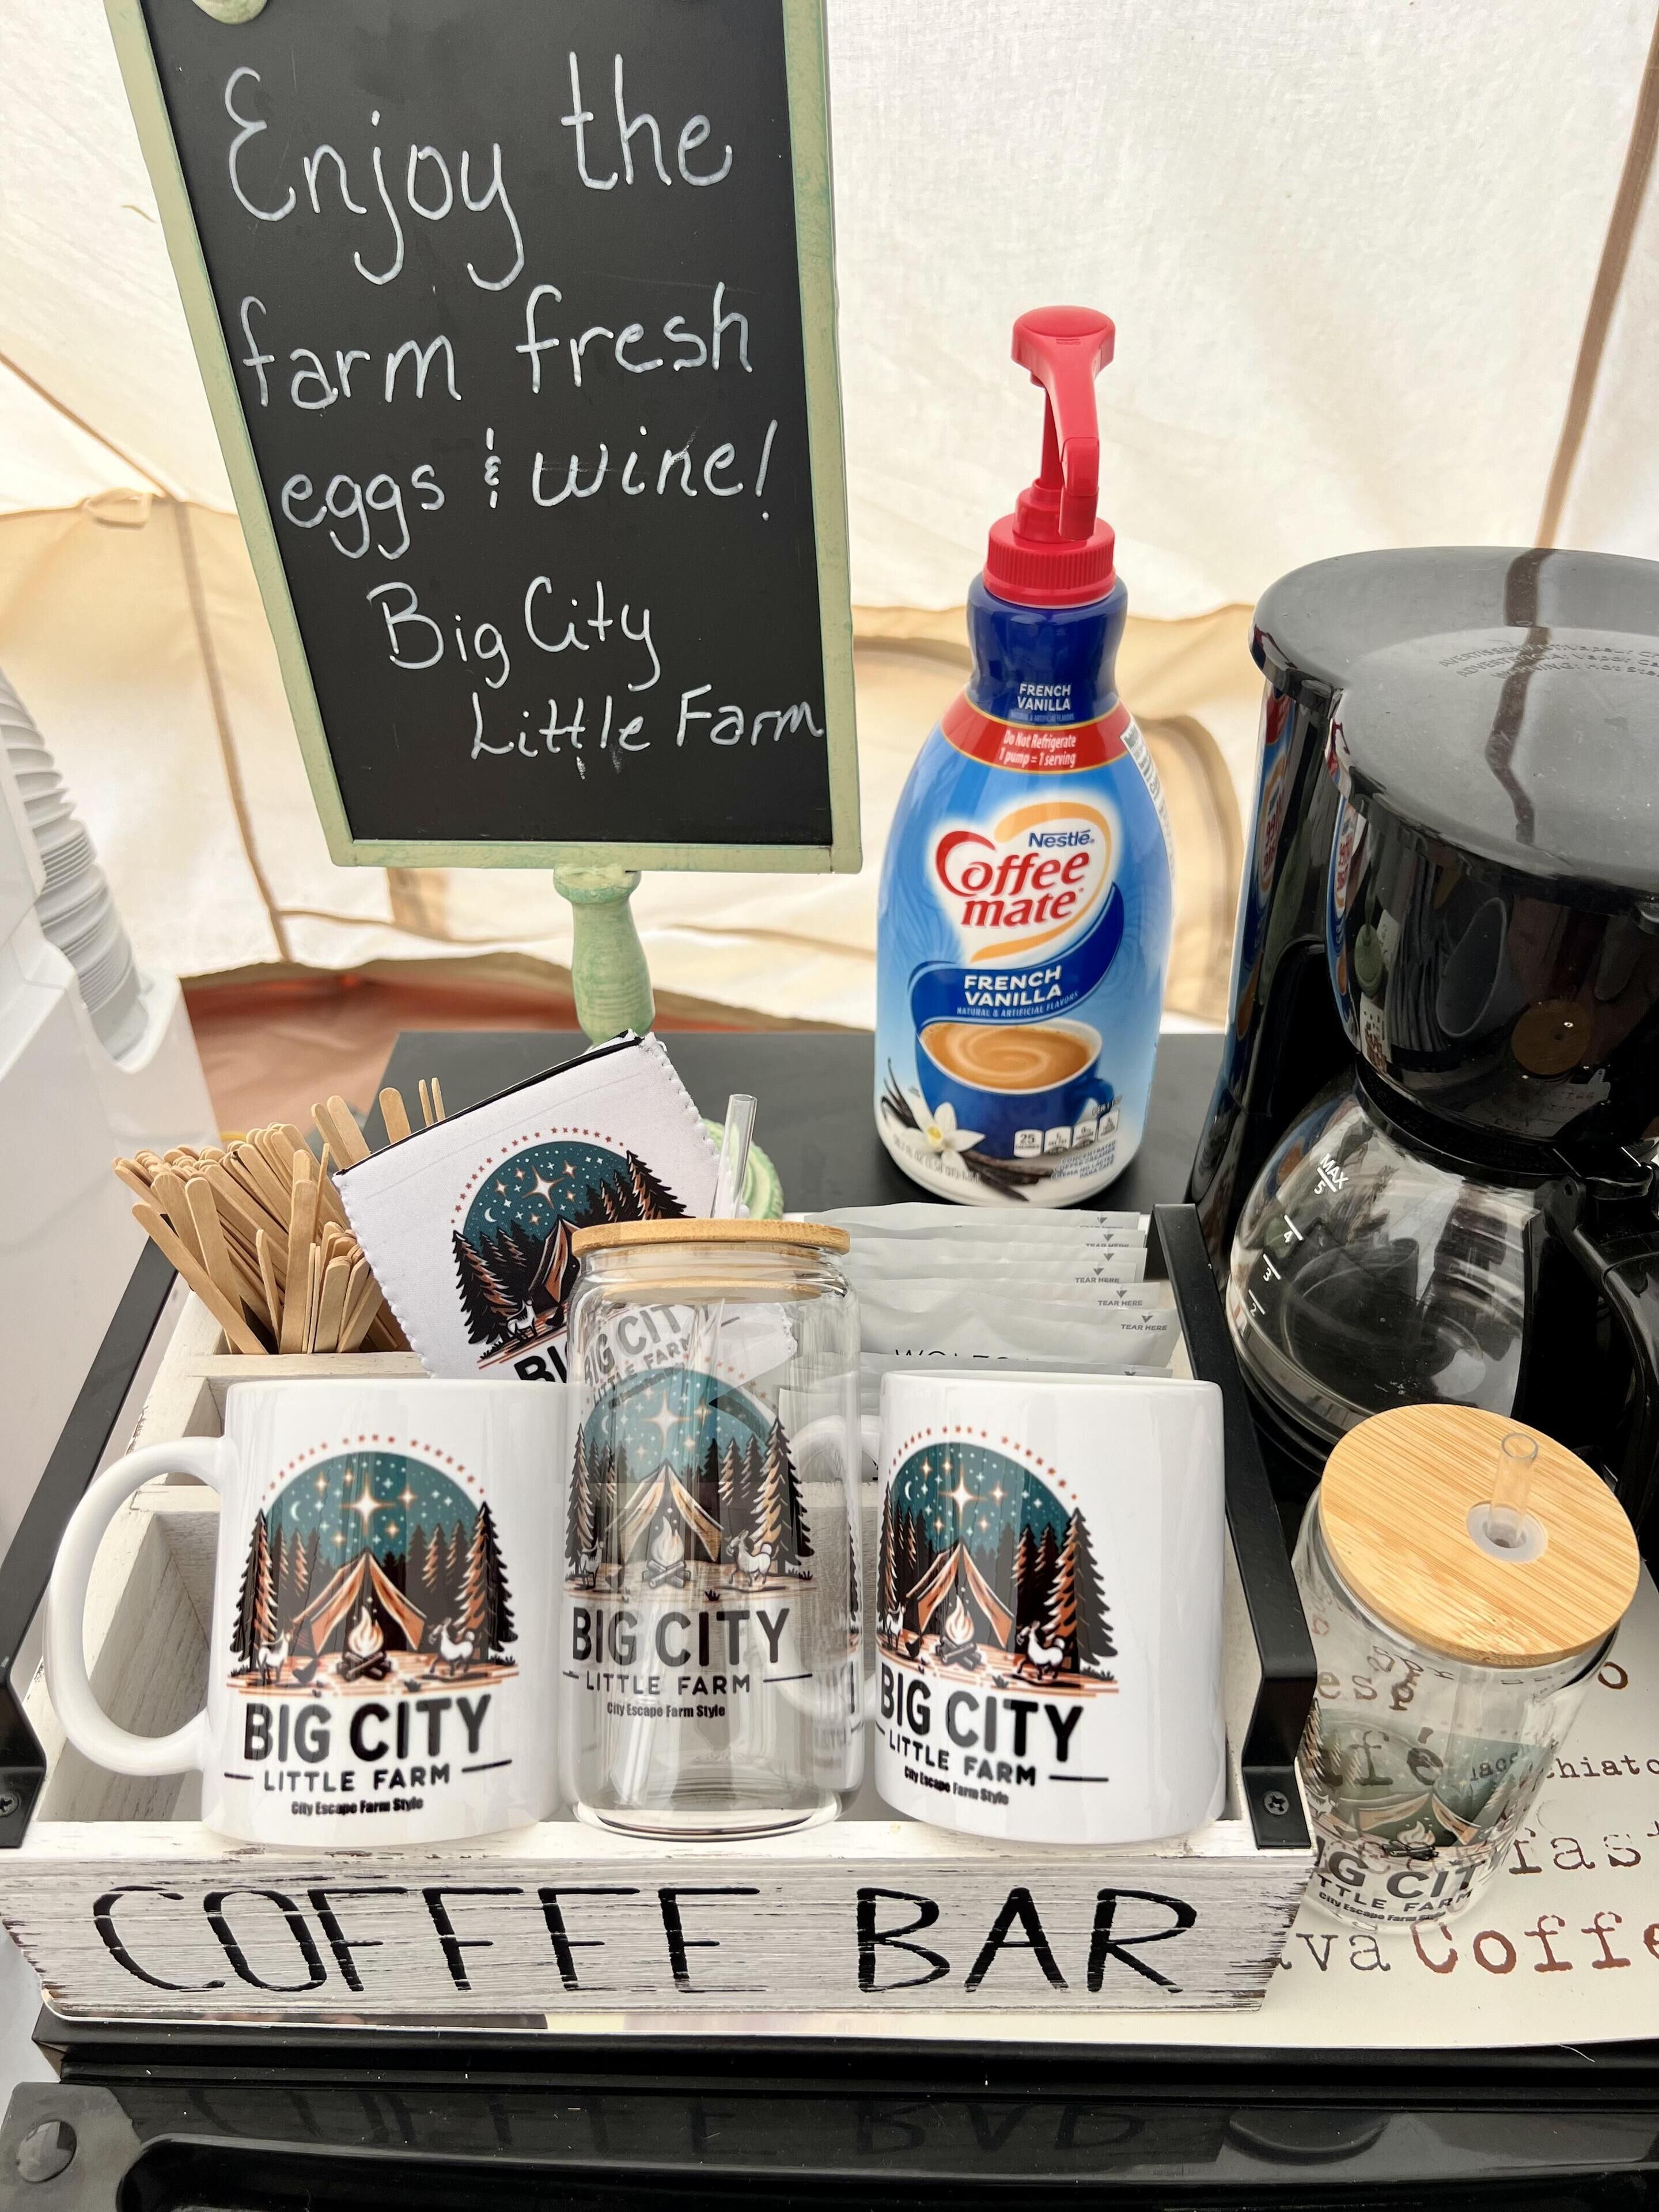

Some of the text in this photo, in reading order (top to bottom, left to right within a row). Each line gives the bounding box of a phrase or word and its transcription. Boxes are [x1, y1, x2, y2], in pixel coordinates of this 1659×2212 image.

[225, 51, 733, 291] Enjoy the
[241, 282, 752, 409] farm fresh
[282, 464, 445, 560] eggs
[532, 419, 779, 521] wine!
[367, 576, 661, 691] Big City
[1017, 696, 1071, 711] VANILLA
[1019, 683, 1071, 696] FRENCH
[471, 684, 825, 760] Little Farm
[1003, 729, 1076, 752] Do Not Refrigerate
[999, 747, 1076, 768] 1 pump = 1 serving
[1029, 830, 1090, 848] Nestlé
[935, 830, 1089, 897] Coffee
[961, 890, 1077, 929] mate
[964, 965, 1062, 991] FRENCH
[957, 990, 1079, 1017] NATURAL & ARTIFICIAL FLAVORS
[964, 984, 1062, 1006] VANILLA
[1020, 1133, 1035, 1144] 25
[1319, 1153, 1349, 1190] MAX
[1314, 1180, 1326, 1195] 5
[1283, 1230, 1294, 1243] 4
[1263, 1267, 1272, 1282] 3
[1249, 1302, 1257, 1317] 2
[514, 1346, 568, 1384] BI
[573, 1607, 790, 1667] BIG CITY
[586, 1671, 750, 1695] LITTLE FARM
[607, 1701, 726, 1718] City Escape Farm Style
[881, 1662, 931, 1736] BIG
[945, 1690, 1084, 1763] CITY
[244, 1693, 492, 1763] BIG CITY
[889, 1728, 1036, 1787] LITTLE FARM
[263, 1763, 450, 1791] LITTLE FARM
[904, 1765, 1010, 1806] City Escape Farm Style
[291, 1795, 424, 1816] City Escape Farm Style
[1319, 1891, 1342, 1907] City
[1343, 1903, 1385, 1920] Escape
[94, 1885, 1197, 1996] COFFEE BAR
